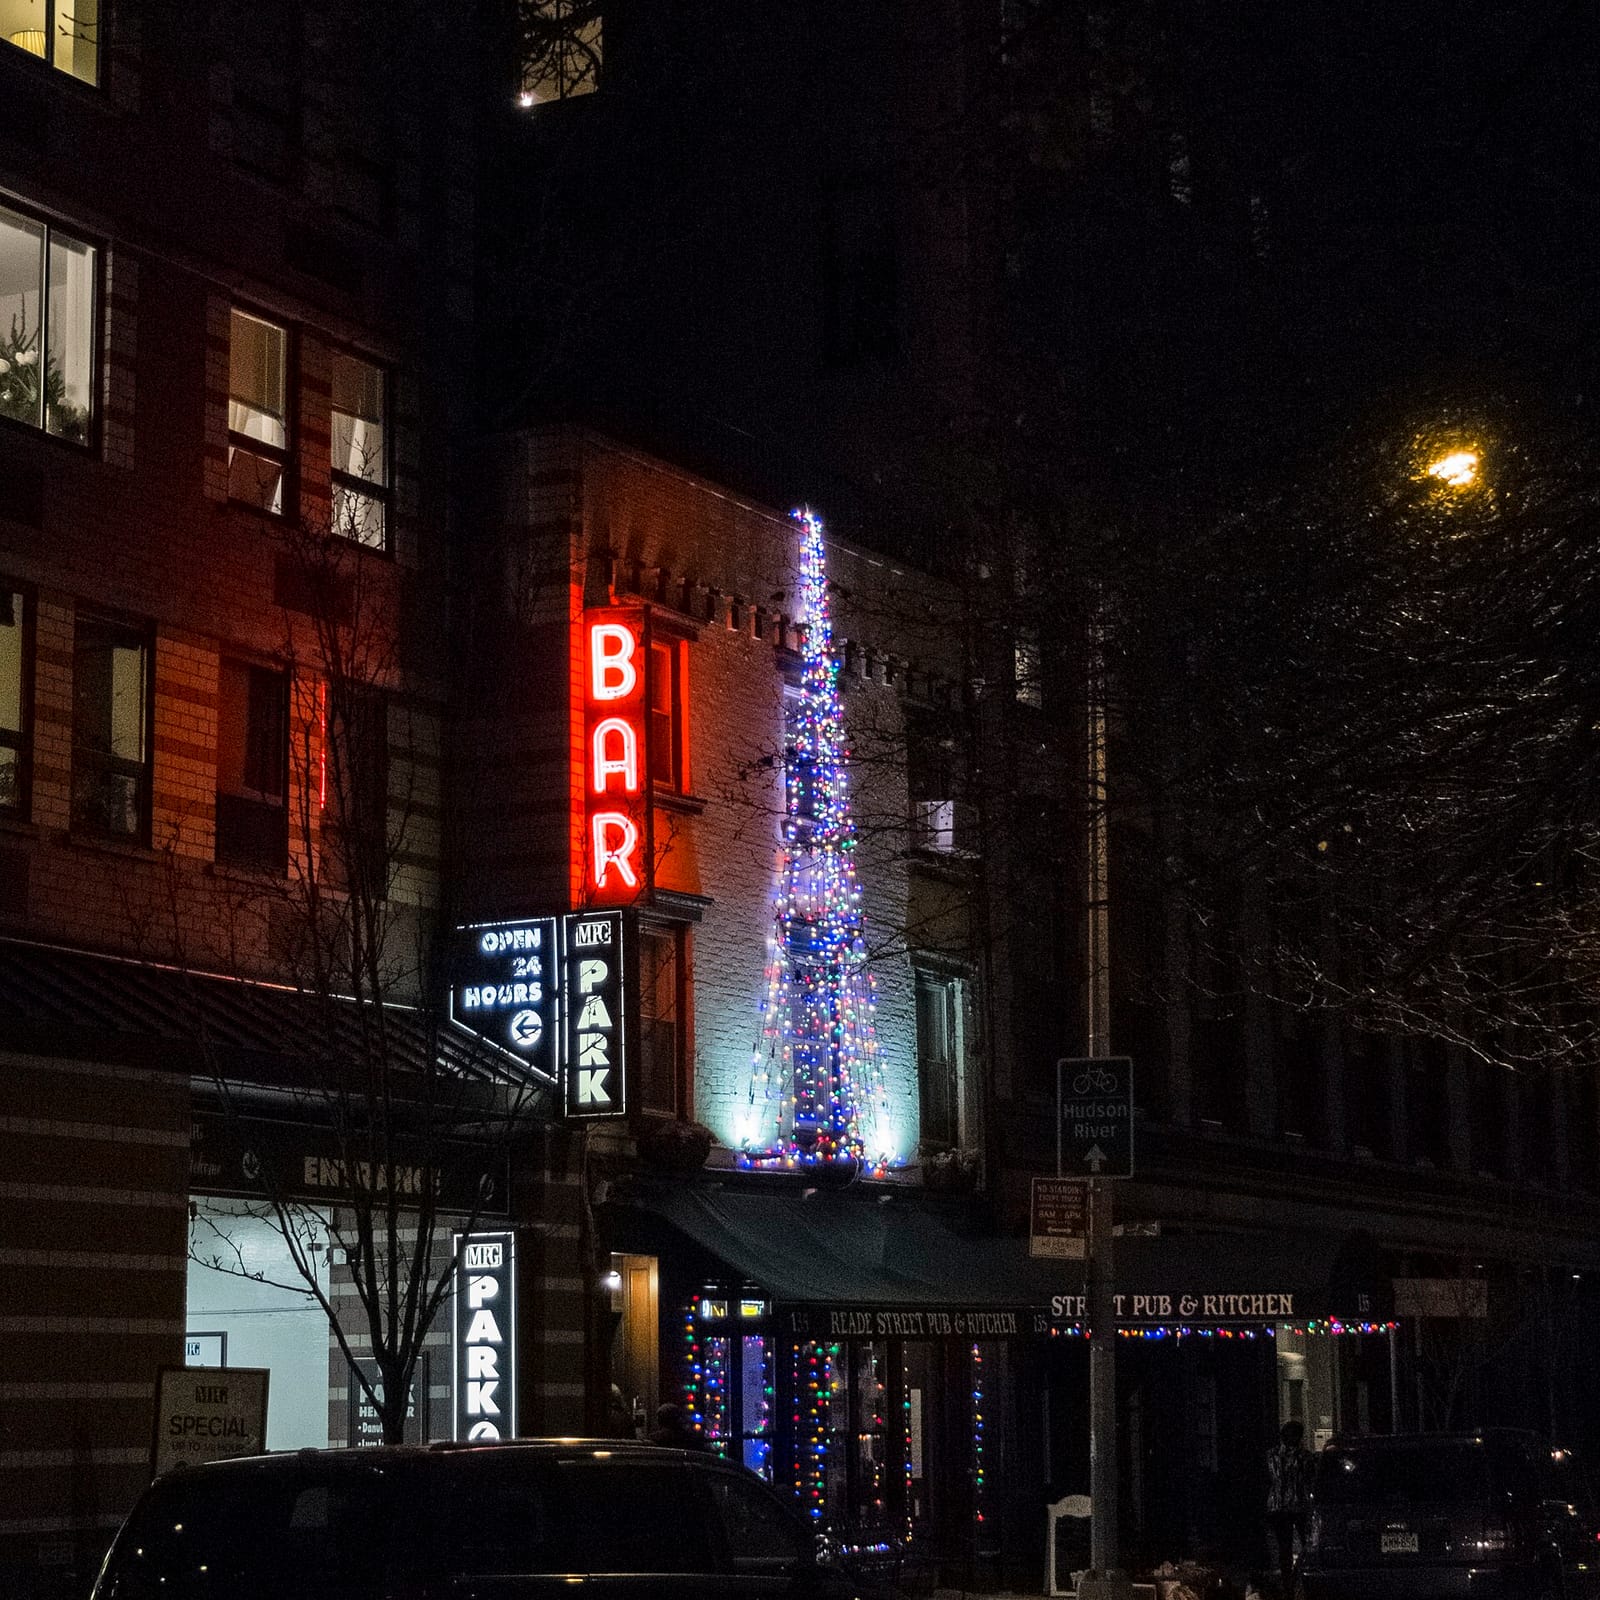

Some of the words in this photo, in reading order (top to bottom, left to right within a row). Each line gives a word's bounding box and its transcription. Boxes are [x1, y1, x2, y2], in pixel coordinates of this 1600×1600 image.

[591, 624, 637, 887] BAR
[481, 928, 541, 952] OPEN
[512, 956, 542, 977] 24
[464, 982, 542, 1008] HOURS
[577, 960, 612, 1104] PARK
[1063, 1103, 1127, 1119] Hudson
[1074, 1124, 1117, 1138] River
[1051, 1295, 1126, 1317] STRT
[1133, 1295, 1172, 1316] PUB
[1179, 1295, 1199, 1315] &
[1203, 1294, 1294, 1315] KITCHEN
[830, 1311, 873, 1335] READE
[876, 1311, 923, 1335] STREET
[926, 1312, 952, 1335] PUB
[954, 1312, 965, 1335] &
[966, 1312, 1017, 1335] KITCHEN
[466, 1275, 502, 1415] PARK
[360, 1384, 415, 1403] PAK
[168, 1415, 249, 1437] SPECIAL
